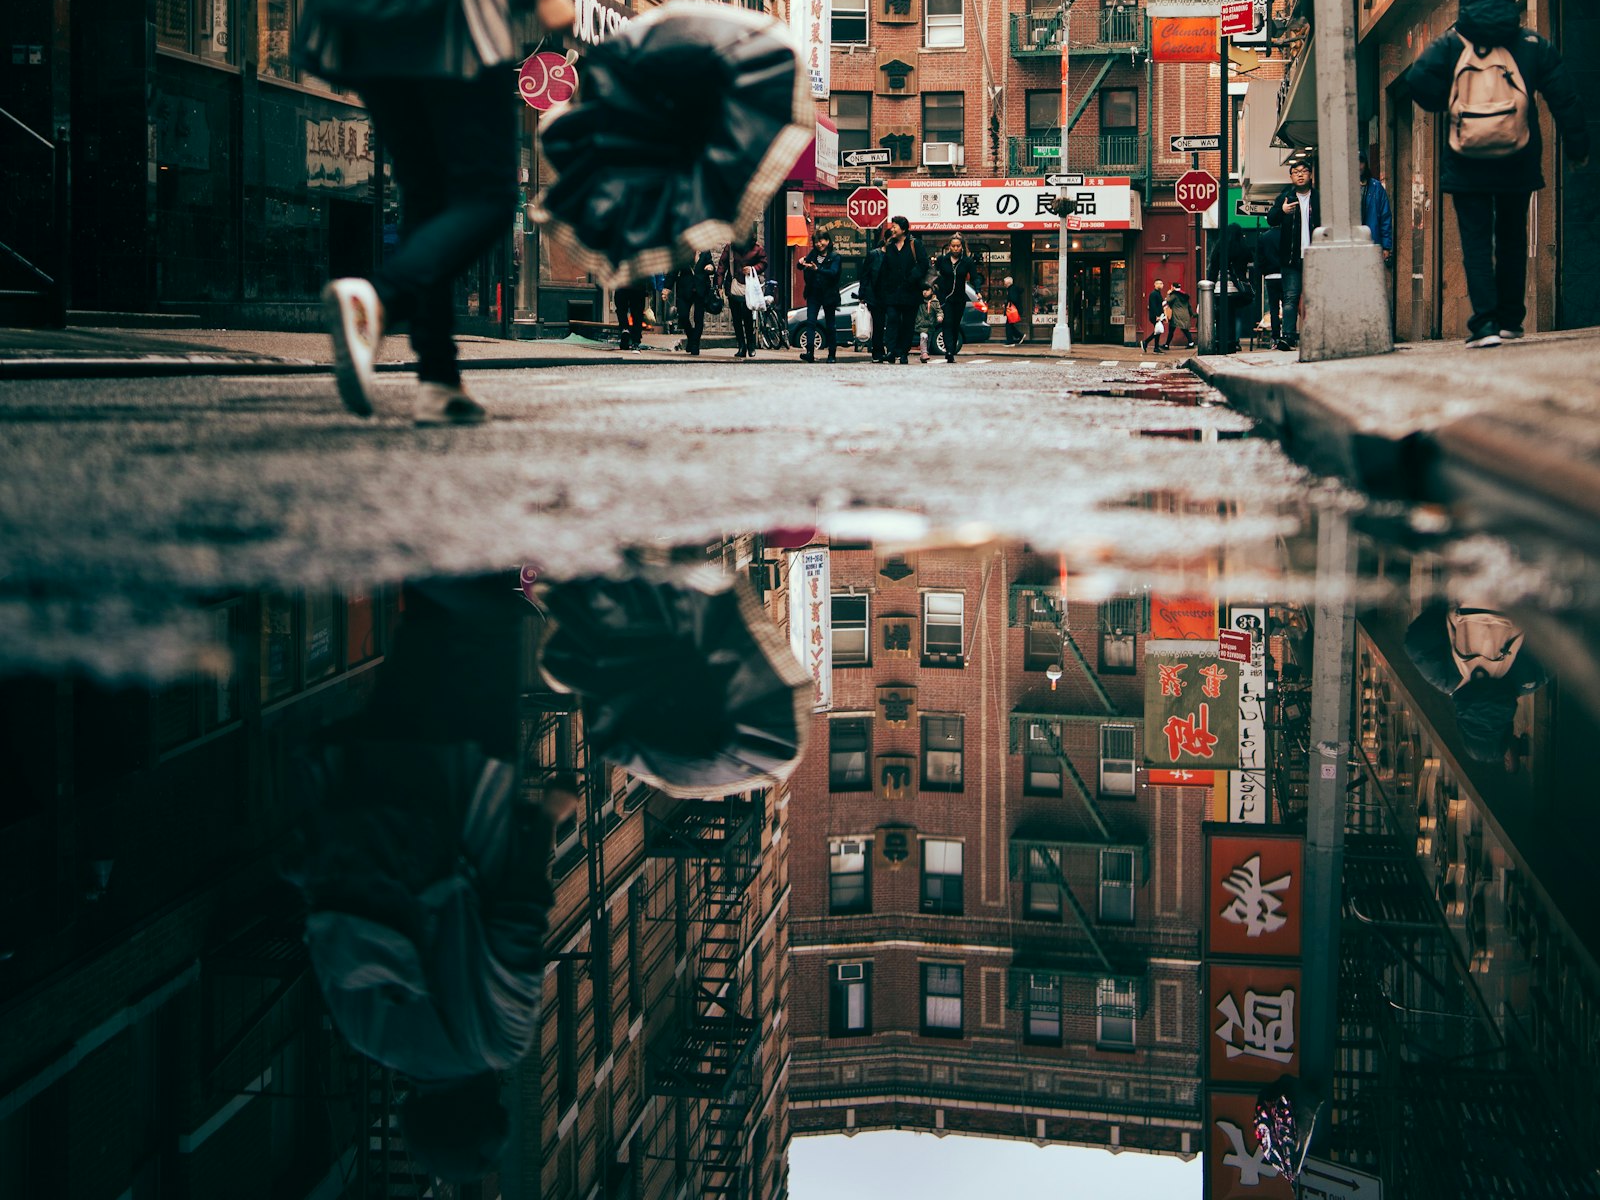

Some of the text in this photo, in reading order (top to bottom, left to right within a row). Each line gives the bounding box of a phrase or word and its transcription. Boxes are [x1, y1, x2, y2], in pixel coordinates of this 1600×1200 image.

[1229, 4, 1249, 13] STANDING
[1222, 13, 1239, 21] Anytime
[1178, 183, 1216, 199] STOP
[850, 200, 887, 216] STOP
[956, 192, 1097, 216] 優の良品
